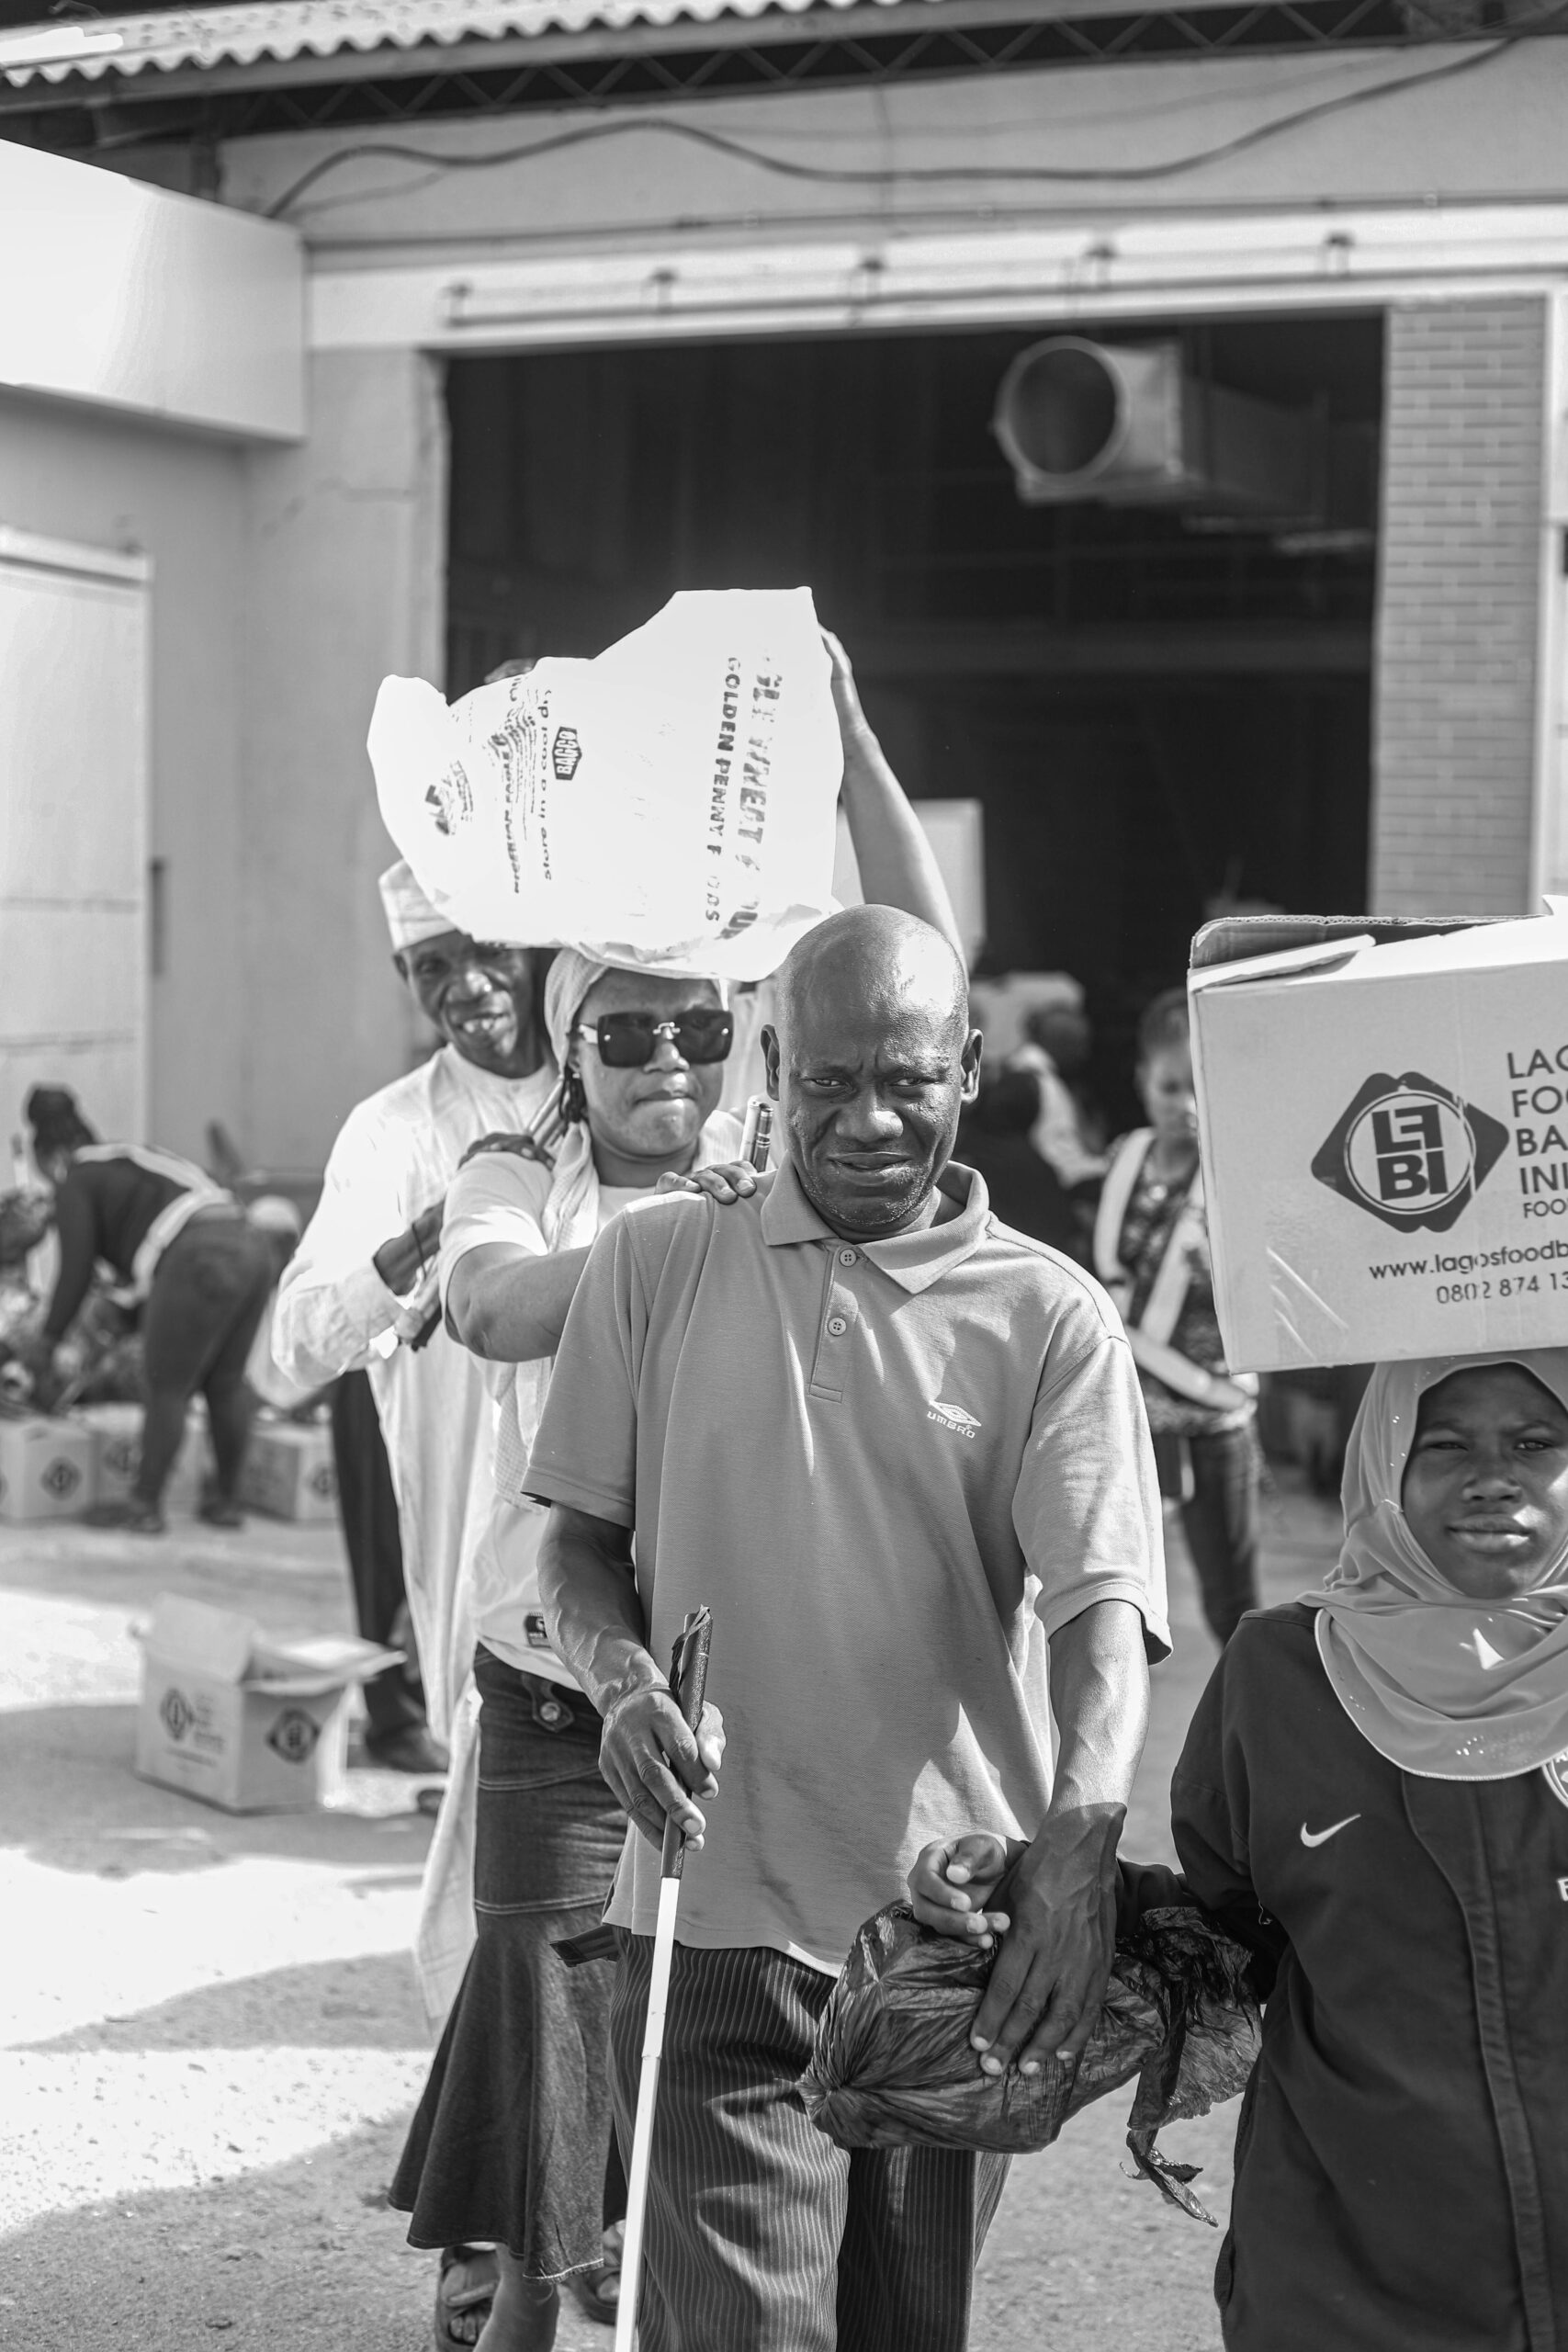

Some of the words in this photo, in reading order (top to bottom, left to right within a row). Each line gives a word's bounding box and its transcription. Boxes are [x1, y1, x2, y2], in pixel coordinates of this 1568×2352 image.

[717, 657, 740, 752] GOLDEN
[553, 729, 581, 775] BAGCO
[540, 778, 547, 791] a
[709, 758, 731, 836] PENNY
[538, 799, 547, 819] in
[540, 826, 552, 881] store
[1511, 1085, 1568, 1118] FO
[1522, 1198, 1568, 1219] FOO
[1436, 1280, 1492, 1305] 0802
[1498, 1274, 1540, 1297] 874
